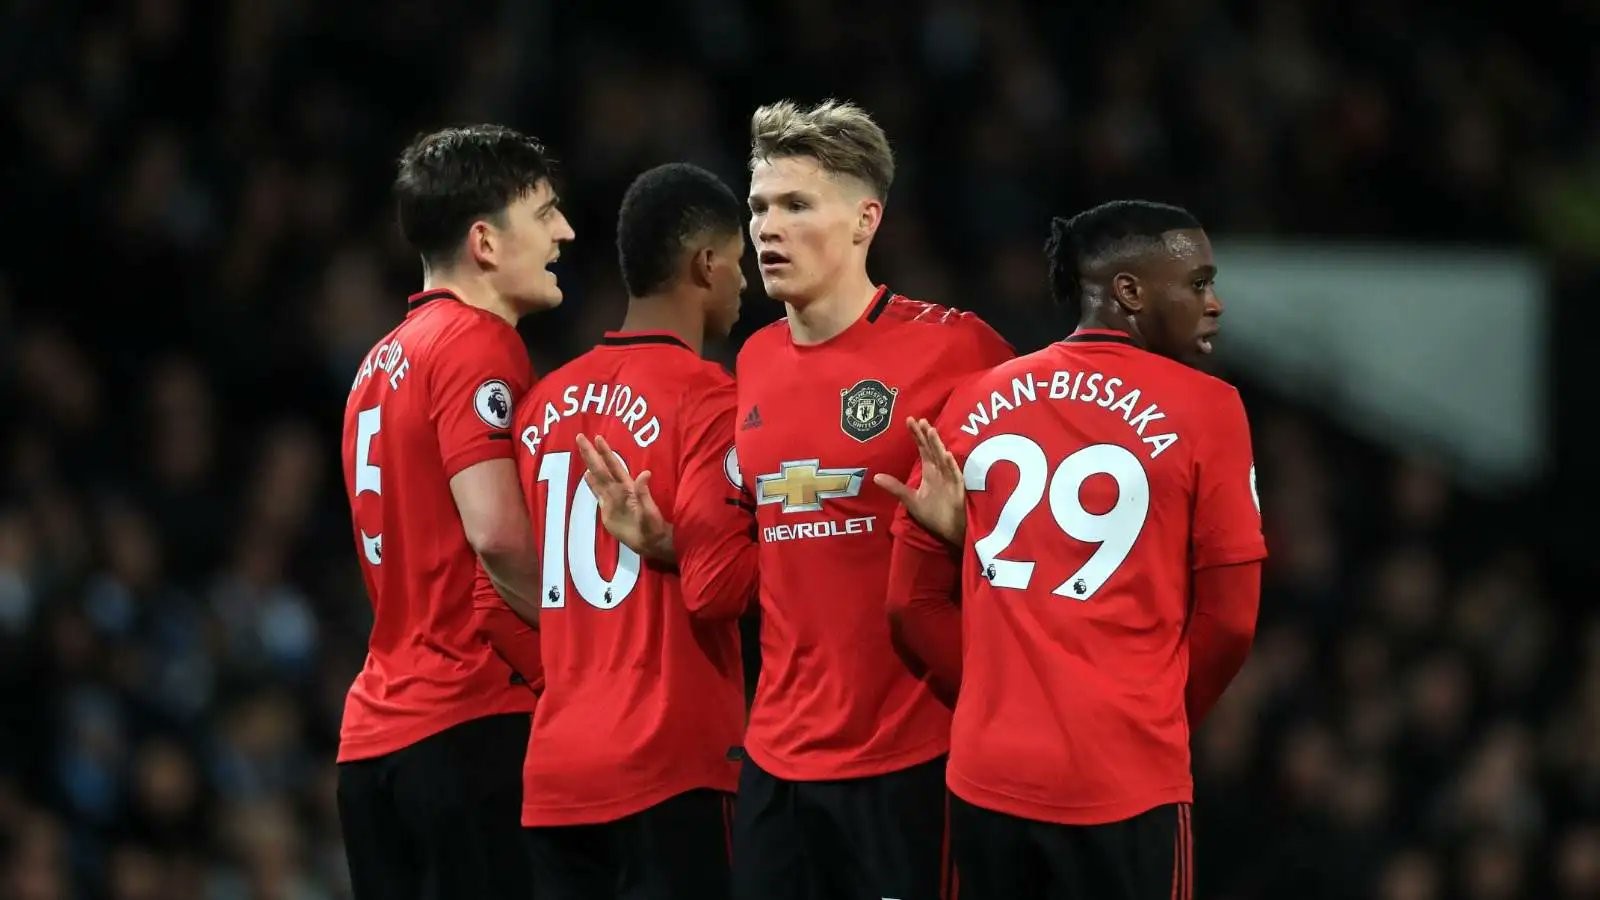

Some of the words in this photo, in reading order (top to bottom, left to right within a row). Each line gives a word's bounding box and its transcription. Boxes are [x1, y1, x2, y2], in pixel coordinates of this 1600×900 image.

[960, 370, 1179, 460] WAN-BISSAKA
[537, 451, 641, 610] 10
[763, 515, 877, 543] CHEVROLET
[962, 433, 1151, 601] 29
